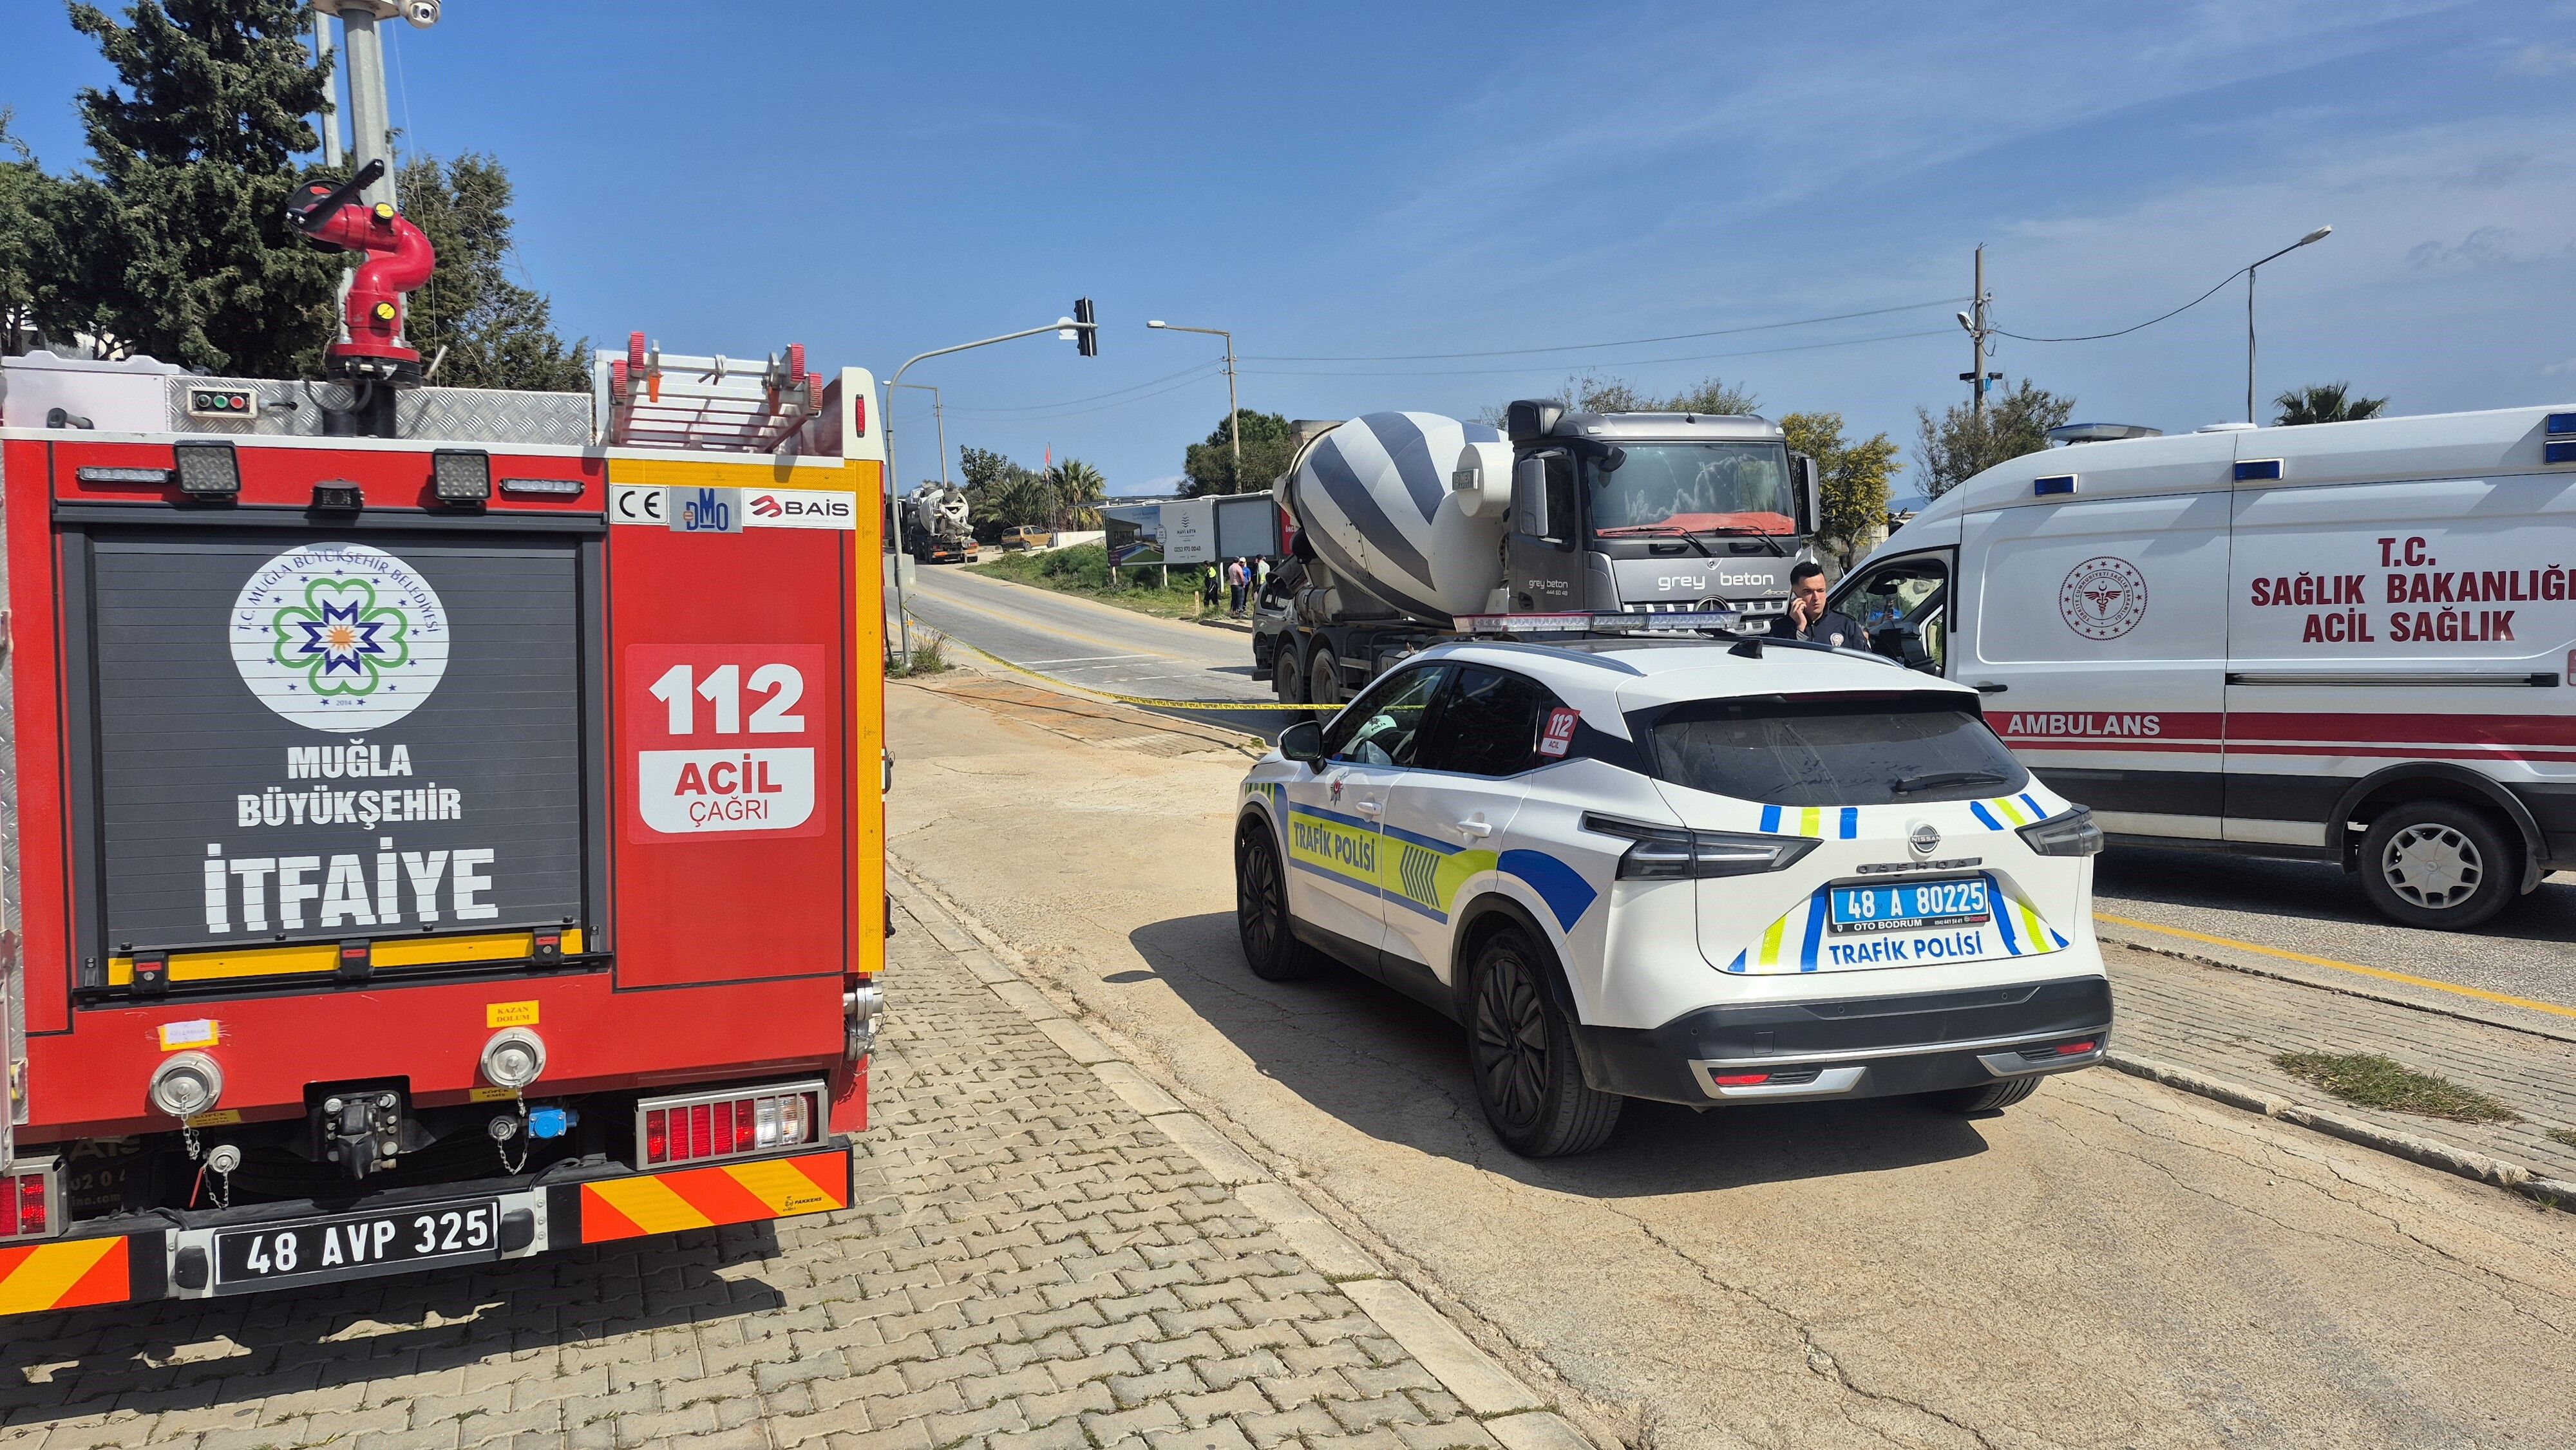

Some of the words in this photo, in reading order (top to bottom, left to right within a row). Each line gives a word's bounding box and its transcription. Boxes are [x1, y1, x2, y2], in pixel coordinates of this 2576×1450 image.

[619, 490, 661, 519] CE
[2378, 536, 2436, 567] T.C.
[238, 610, 257, 632] T.C.
[248, 563, 293, 606] MUĞLA
[293, 548, 390, 574] BÜYÜKŞEHİR
[390, 569, 442, 633] BELEDİYESİ
[1529, 579, 1545, 589] grey
[1546, 578, 1568, 588] beton
[1658, 575, 1705, 591] grey
[1719, 572, 1774, 586] beton
[2251, 571, 2365, 607] SAĞLIK
[2302, 607, 2374, 643] ACİL
[2389, 606, 2515, 642] SAĞLIK
[648, 663, 805, 735] 112
[1549, 713, 1573, 737] 112
[2007, 714, 2161, 735] AMBULANS
[287, 738, 413, 779] MUĞLA
[674, 753, 782, 796] ACİL
[237, 782, 462, 830] BÜYÜKŞEHİR
[689, 796, 768, 828] ÇAĞRI
[1294, 821, 1332, 858] TRAFİK
[1335, 834, 1375, 873] POLİSİ
[204, 837, 499, 934] İTFAİYE
[1848, 890, 1875, 919] 48
[1890, 888, 1904, 917] A
[1916, 882, 1985, 915] 80225
[1854, 921, 1876, 931] OTO
[1878, 919, 1922, 930] BODRUM
[1828, 936, 1909, 966] TRAFİK
[1913, 930, 1984, 959] POLİSİ
[497, 1014, 530, 1022] DOLUM
[498, 1006, 529, 1014] KAZAN
[247, 1232, 297, 1274] 48
[321, 1220, 396, 1266] AVP
[413, 1209, 488, 1254] 325
